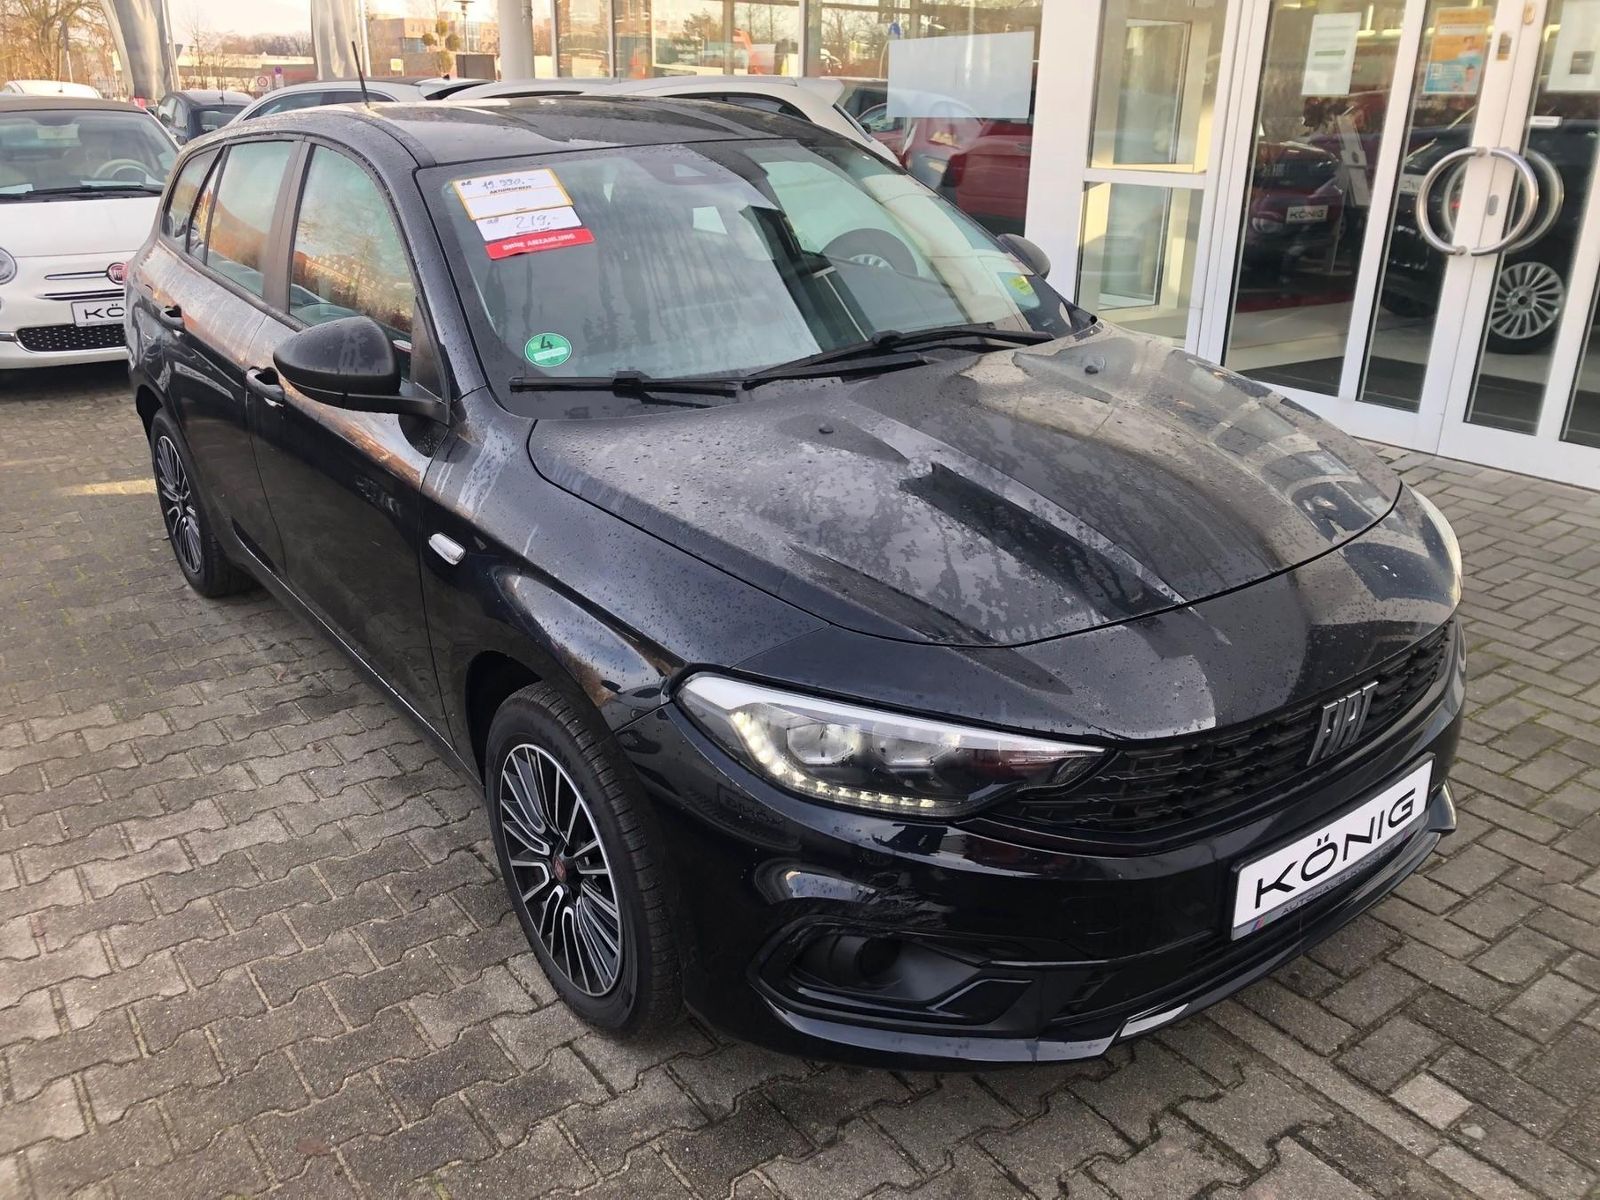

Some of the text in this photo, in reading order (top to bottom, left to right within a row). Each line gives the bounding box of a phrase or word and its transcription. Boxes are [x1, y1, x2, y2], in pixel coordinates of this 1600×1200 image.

[527, 233, 576, 247] ANZAHLUNG
[540, 335, 554, 350] 4
[1306, 681, 1379, 767] FIAT
[1254, 787, 1416, 910] KÖNIG
